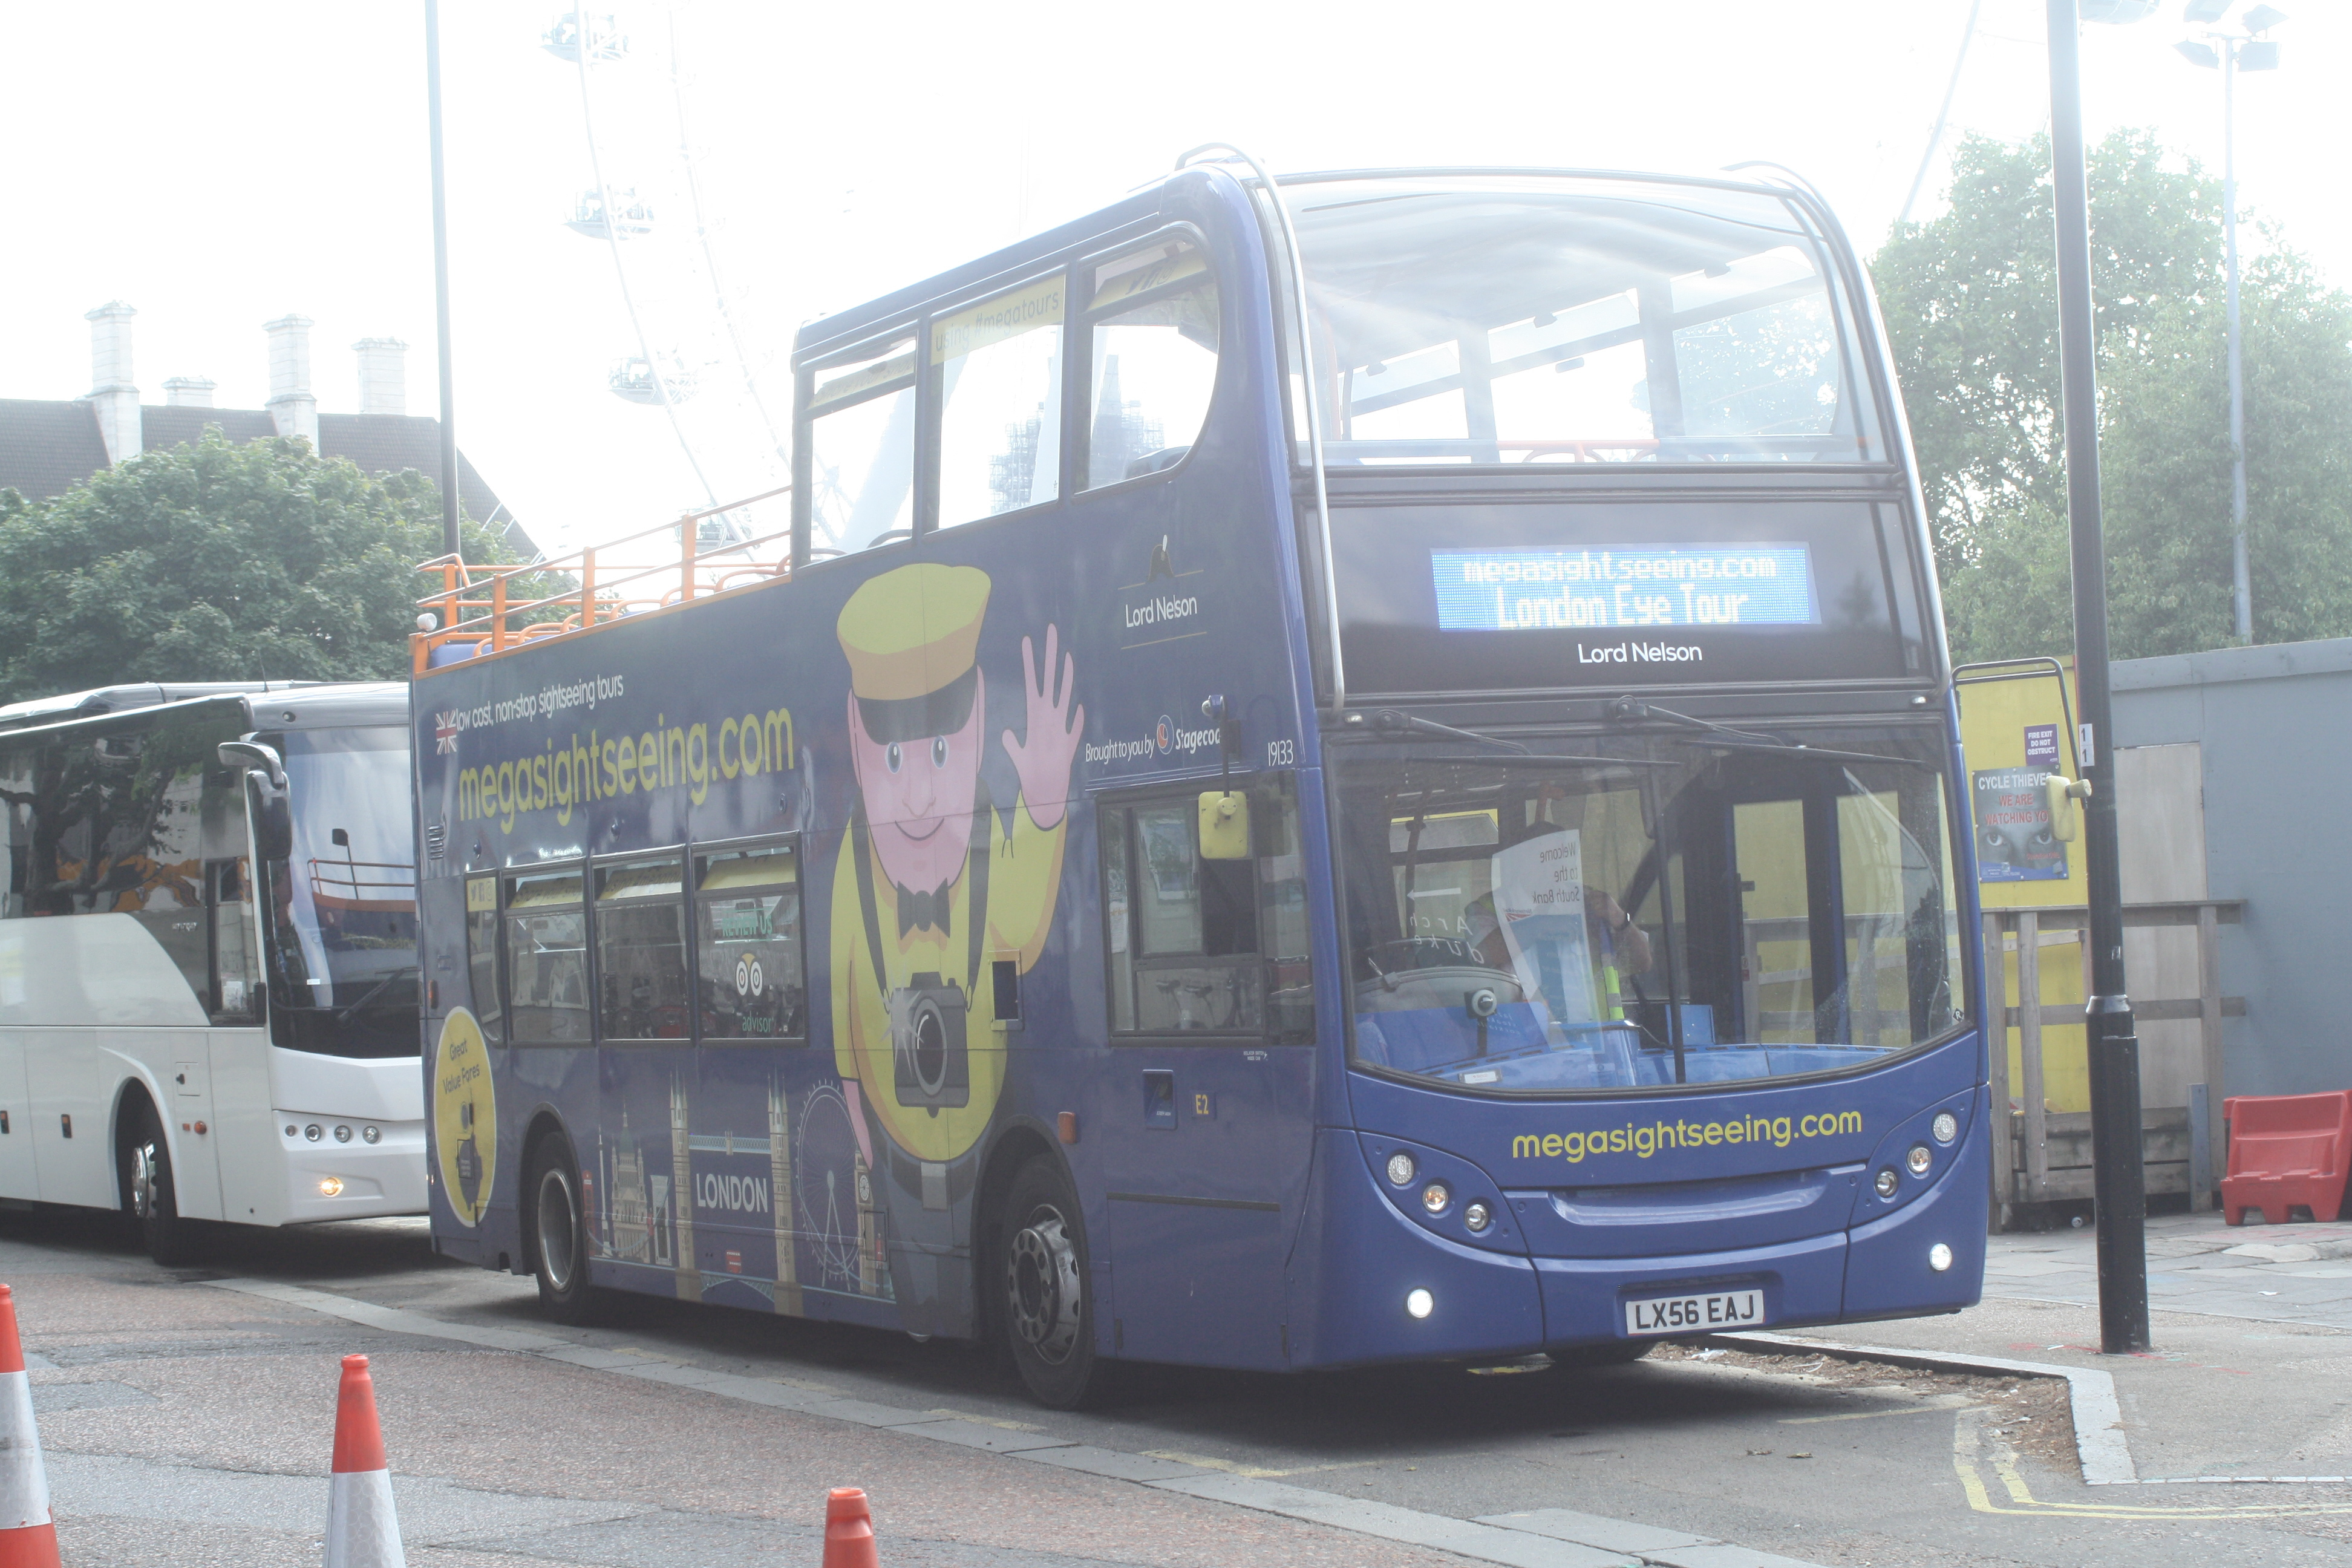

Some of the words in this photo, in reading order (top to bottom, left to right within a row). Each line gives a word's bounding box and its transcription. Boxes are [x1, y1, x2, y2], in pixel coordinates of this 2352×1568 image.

[935, 323, 969, 351] using
[975, 291, 1059, 336] #megatours
[1465, 550, 1777, 582] megasightseeing.com
[1125, 599, 1154, 628] Lord
[1157, 595, 1197, 622] Nelson
[1495, 585, 1608, 628] London
[1613, 585, 1673, 626] Eye
[1679, 583, 1749, 624] Tour
[1578, 642, 1627, 664] Lord
[1632, 641, 1703, 662] Nelson
[456, 708, 471, 731] low
[472, 701, 493, 726] cost,
[495, 693, 537, 722] non-stop
[539, 679, 595, 719] sightseeing
[597, 674, 624, 700] tours
[2081, 728, 2086, 742] 1
[1085, 739, 1118, 765] Brought
[1119, 737, 1127, 756] to
[1128, 737, 1144, 762] you
[1145, 734, 1155, 759] by
[1268, 740, 1293, 766] 19133
[2027, 746, 2056, 755] OBSTRUCT
[2082, 748, 2087, 762] 1
[459, 708, 794, 835] megasightseeing.com
[1979, 775, 2010, 790] CYCLE
[1999, 794, 2013, 806] WE
[2015, 794, 2033, 805] ARE
[1985, 811, 2033, 826] WATCHING
[2035, 810, 2049, 823] YO
[722, 917, 759, 937] REVIEW
[760, 914, 773, 935] US
[742, 1011, 771, 1033] advisor
[1955, 1011, 1962, 1020] R
[449, 1037, 468, 1062] Great
[443, 1074, 461, 1094] Value
[461, 1063, 480, 1085] Fares
[1195, 1094, 1209, 1114] E2
[1512, 1110, 1862, 1163] megasightseeing.com
[696, 1172, 768, 1213] LONDON
[1636, 1300, 1699, 1330] LX56
[1707, 1295, 1754, 1323] EAJ
